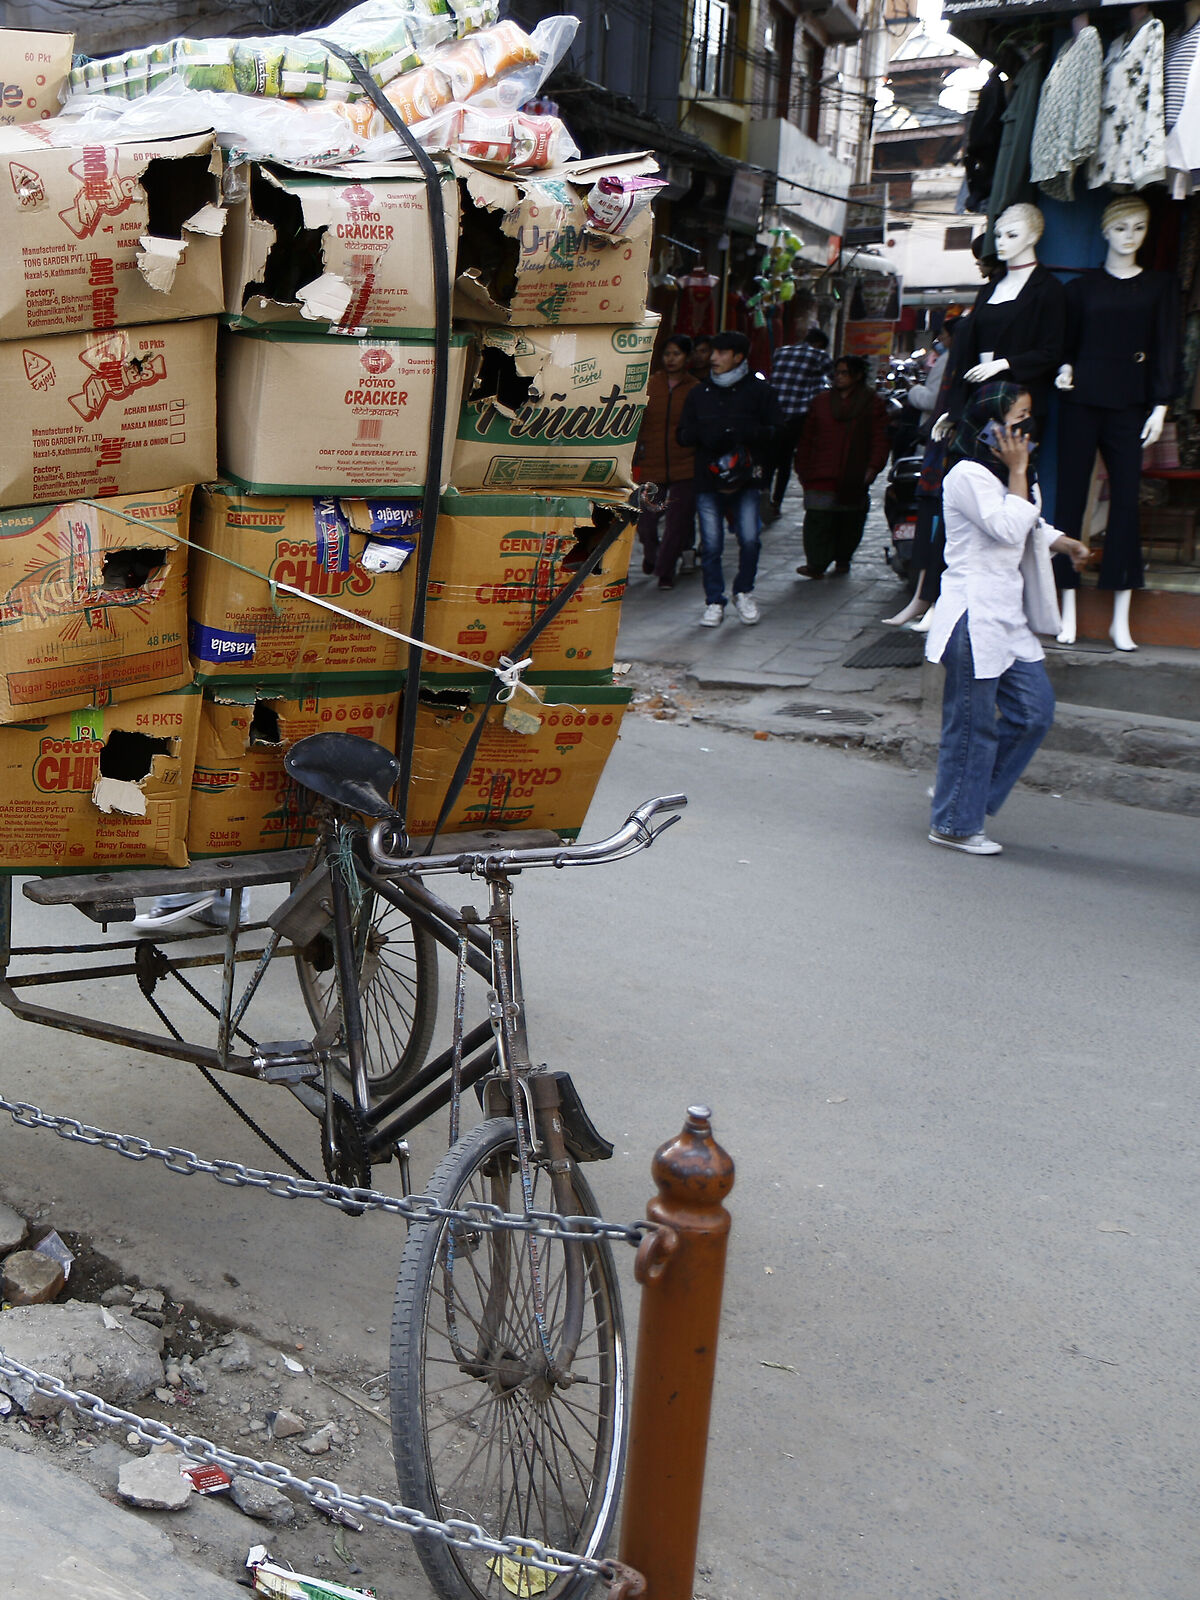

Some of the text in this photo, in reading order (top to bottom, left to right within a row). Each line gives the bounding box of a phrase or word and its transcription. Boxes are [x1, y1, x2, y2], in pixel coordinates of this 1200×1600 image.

[24, 52, 51, 64] 60 Pkt
[133, 153, 144, 161] 60
[336, 223, 394, 240] CRACKER
[117, 239, 140, 248] MASAL
[22, 244, 77, 256] Manufactured by:
[23, 258, 41, 268] TONG
[42, 255, 69, 266] GARDEN
[70, 254, 85, 263] PVT.
[25, 288, 55, 298] Factory:
[65, 315, 84, 323] Nepal
[139, 341, 149, 350] 60
[616, 333, 638, 348] 60
[573, 361, 597, 373] NEW
[30, 366, 57, 392] Enjoy!
[570, 369, 602, 384] Taste!
[359, 378, 396, 388] POTATO
[344, 389, 408, 406] CRACKER
[123, 403, 168, 416] ACHARI MASTI
[32, 425, 84, 436] Manufactured by:
[121, 418, 168, 431] MASALA MAGIC
[33, 438, 50, 448] TONG
[51, 436, 76, 446] GARDEN
[77, 435, 91, 443] PVT.
[142, 439, 148, 447] &
[33, 465, 61, 475] Factory:
[68, 486, 86, 495] Nepal
[227, 512, 286, 526] CENTURY
[277, 541, 317, 558] Pota
[326, 523, 338, 574] NTURY
[274, 554, 372, 596] CHIPS
[225, 612, 250, 620] DUGAR
[146, 636, 159, 647] 48
[329, 633, 371, 642] Plain Salted
[350, 645, 377, 653] Tomato
[356, 656, 376, 664] Onion
[14, 684, 42, 695] Dugar
[45, 678, 76, 691] Spices
[78, 675, 86, 683] &
[88, 673, 110, 682] Food
[112, 664, 151, 678] Products
[152, 660, 164, 671] (P)
[135, 712, 183, 726] 54 PKTS
[41, 739, 103, 755] Potato
[37, 756, 100, 791] CHI
[96, 828, 139, 838] Plain Salted
[209, 831, 228, 839] PKTS
[95, 840, 147, 849] Tangy Tomato
[205, 839, 242, 848] Quantity:
